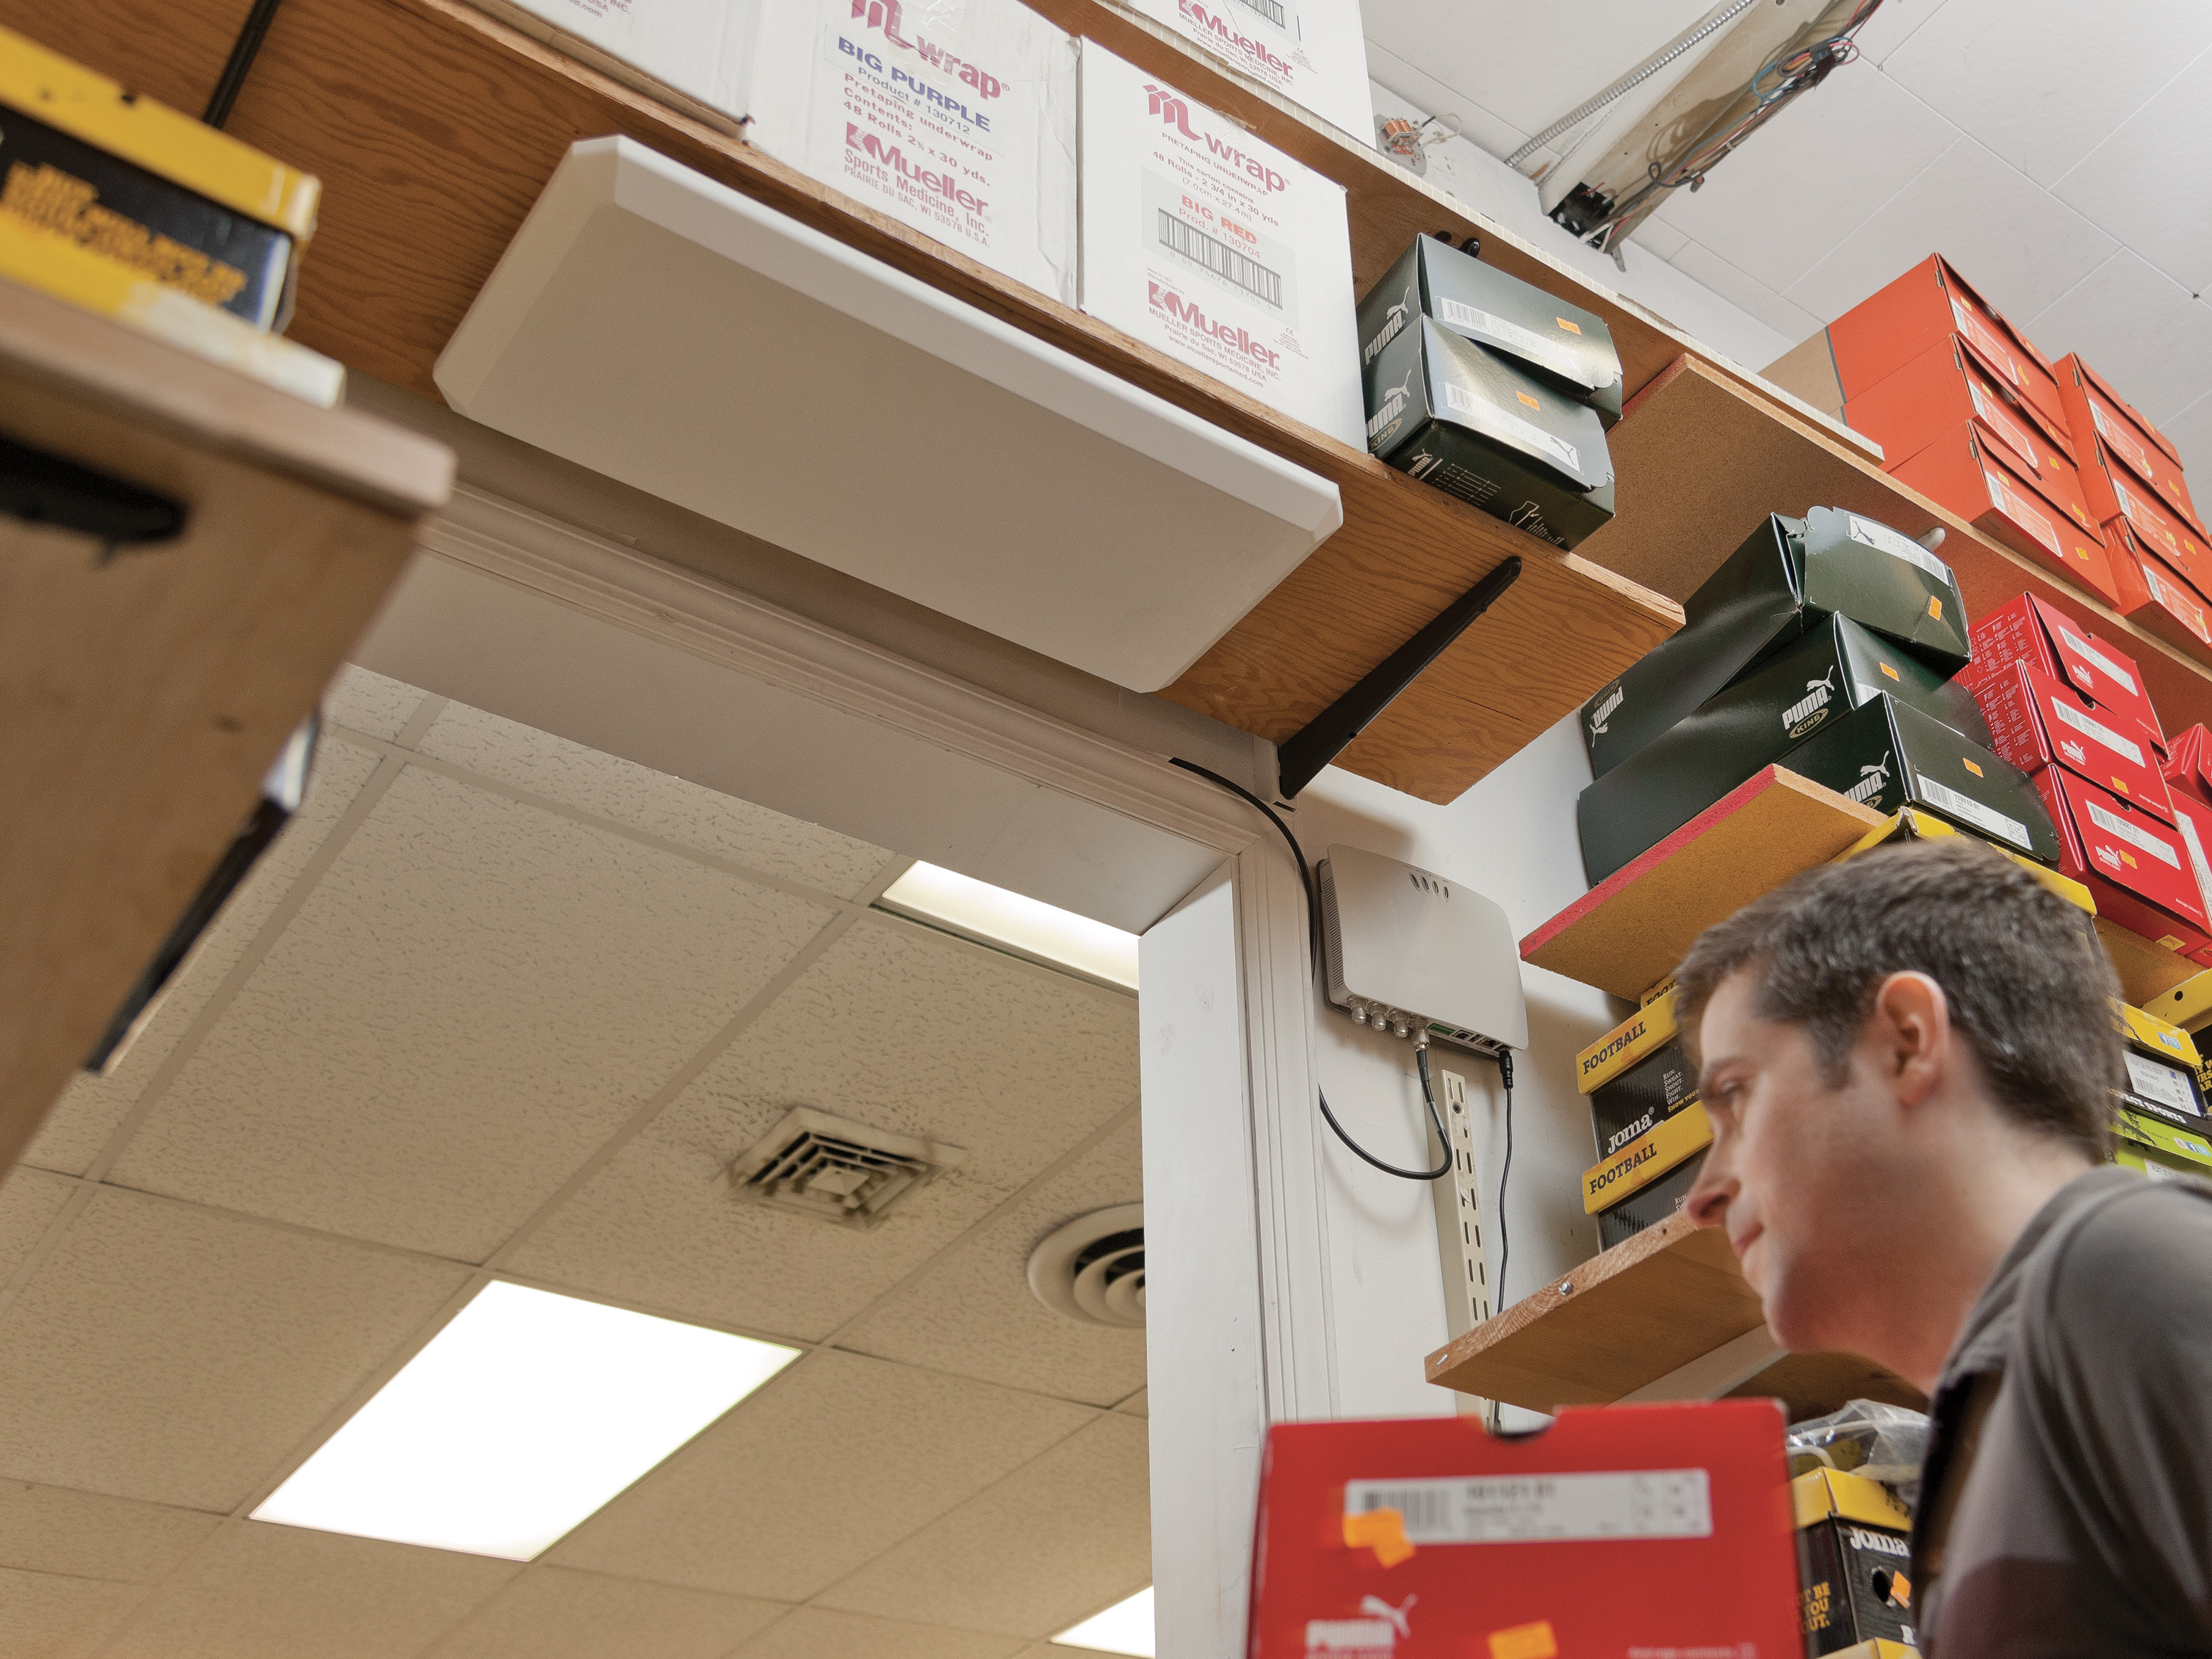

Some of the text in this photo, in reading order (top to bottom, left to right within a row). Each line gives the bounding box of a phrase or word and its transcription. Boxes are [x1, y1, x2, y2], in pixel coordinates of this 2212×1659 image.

[1179, 12, 1212, 37] MUELLER
[1215, 34, 1242, 57] SPORTS
[1244, 53, 1279, 77] MEDICINE,
[1281, 75, 1295, 87] INC.
[1193, 28, 1282, 86] Prairie du Sac, WI 53578 USA
[839, 37, 990, 133] BIG PURPLE
[844, 87, 912, 130] Contents:
[858, 67, 970, 135] Product # 130712
[844, 101, 862, 116] 48
[868, 113, 902, 138] Rolls
[940, 153, 958, 168] 30
[963, 167, 990, 186] yds.
[845, 73, 992, 162] Pretaping underwrap
[1153, 151, 1165, 162] 48
[1167, 159, 1193, 178] Rolls
[1211, 184, 1225, 197] 3/4
[1228, 192, 1237, 203] in
[1248, 205, 1260, 216] 30
[1262, 214, 1279, 227] yds
[1162, 132, 1268, 197] PRETAPING UNDERWRAP
[1178, 156, 1254, 204] This carton contains
[845, 149, 989, 237] Sports Medicine, Inc.
[845, 165, 990, 248] PRAIRIE DU SAC, WI 53578 U.S.A.
[1179, 208, 1209, 230] Prod.
[1223, 233, 1260, 259] 130704
[1182, 195, 1257, 245] BIG RED
[1149, 307, 1281, 382] MUELLER SPORTS MEDICINE, INC.
[1164, 324, 1267, 382] Prairie du Sac, WI 53578 USA
[1168, 335, 1264, 388] www.muellersportsmed.com
[1364, 310, 1403, 366] PUMA
[1365, 393, 1404, 439] UMA
[1782, 685, 1829, 730] PUMA
[1797, 715, 1821, 734] KING
[1843, 771, 1883, 803] UMA
[1583, 1021, 1647, 1075] FOOTBALL
[1663, 1069, 1676, 1080] RUN.
[1664, 1072, 1683, 1087] SWEAT.
[1665, 1078, 1684, 1093] SHOUT.
[1666, 1085, 1683, 1099] FIGHT.
[1667, 1094, 1681, 1105] WIN.
[1668, 1099, 1684, 1112] SHOW
[2144, 1102, 2187, 1124] SPORTS
[1589, 1142, 1658, 1195] FOOTBALL
